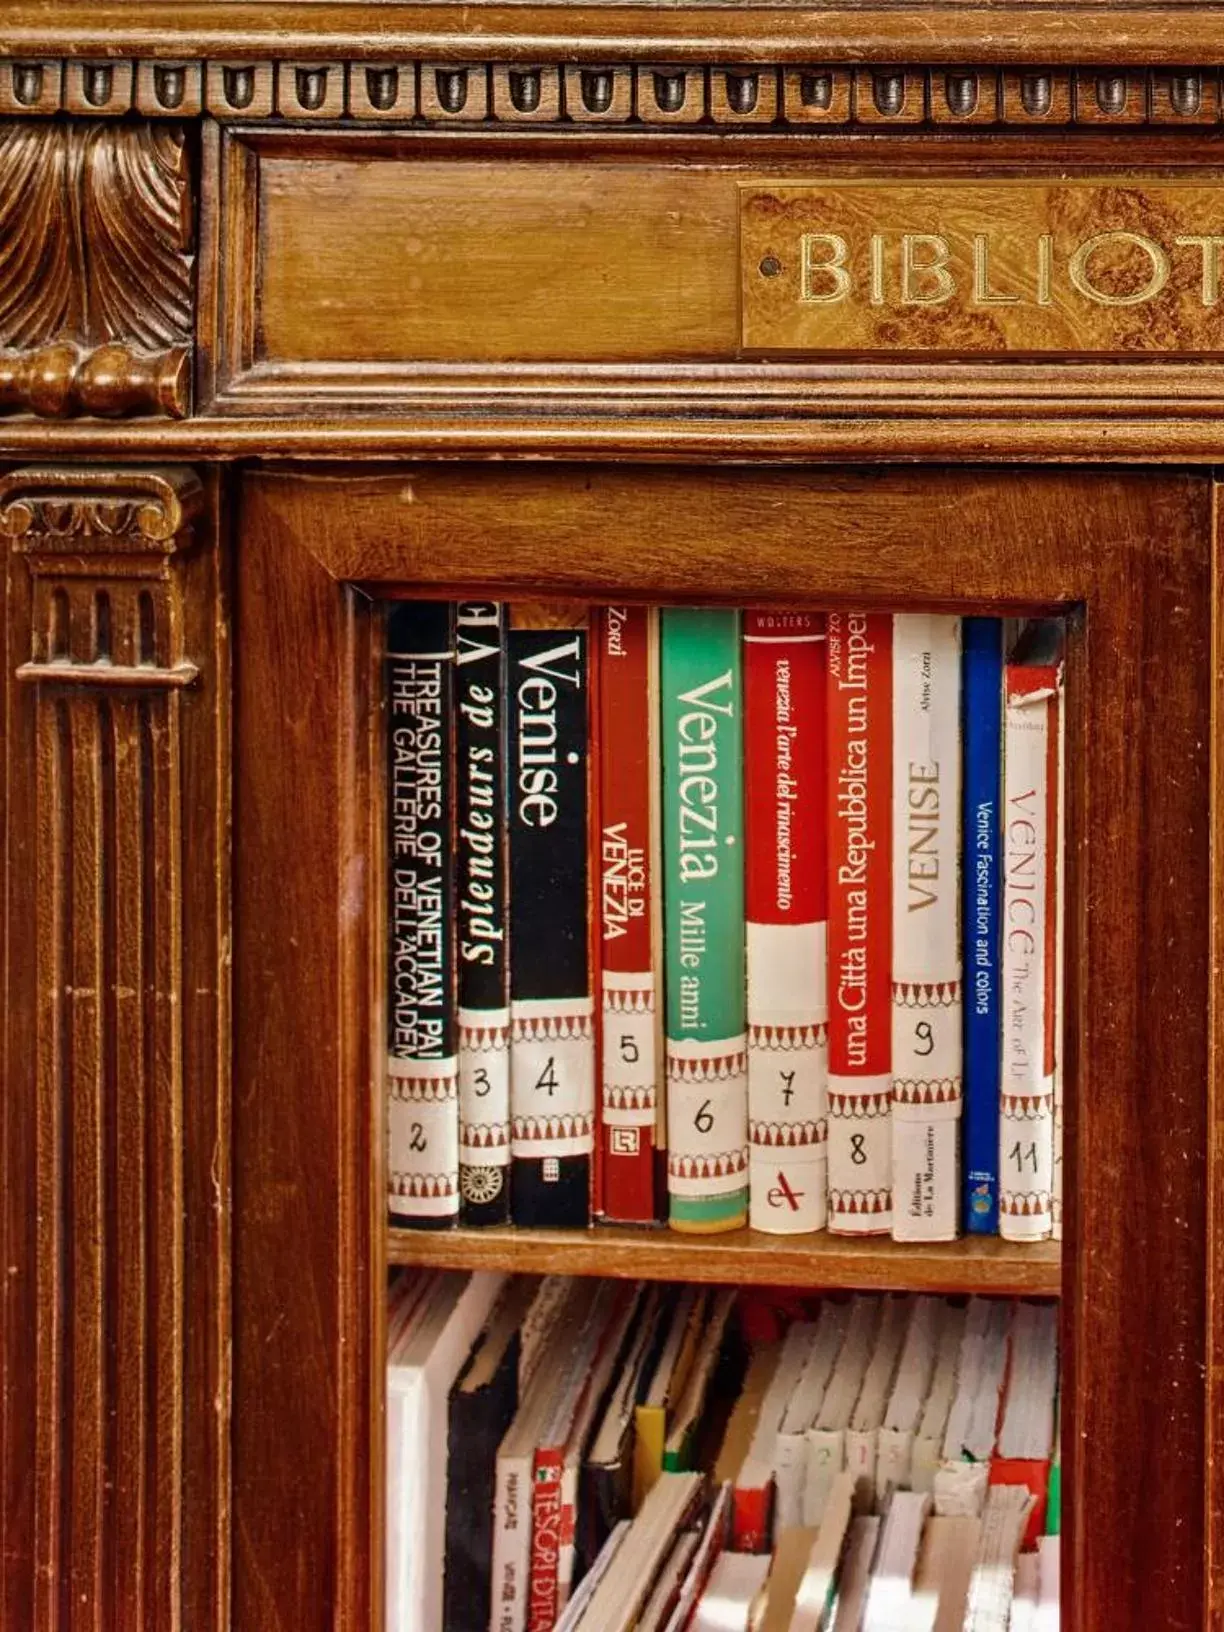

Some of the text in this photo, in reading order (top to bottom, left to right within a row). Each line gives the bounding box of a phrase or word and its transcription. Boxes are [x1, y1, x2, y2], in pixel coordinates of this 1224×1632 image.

[393, 663, 416, 715] THE
[461, 685, 494, 728] de
[775, 659, 790, 722] venezia
[415, 662, 441, 820] TREASURES
[517, 636, 580, 828] Venise
[848, 698, 868, 735] un
[393, 728, 417, 856] GALLERIE
[775, 774, 797, 799] del
[839, 740, 876, 885] Repubblica
[908, 761, 939, 913] VENISE
[977, 801, 993, 850] Venice
[416, 832, 441, 868] OF
[461, 746, 502, 966] Splendeurs
[677, 669, 736, 1029] Venezia Mille anni
[775, 800, 797, 911] rinascimento
[602, 821, 628, 941] VENEZIA
[628, 849, 644, 918] LUCE DI
[416, 877, 443, 1006] VENETIAN
[848, 895, 868, 939] una
[976, 937, 992, 967] and
[838, 952, 868, 1011] Città
[976, 971, 992, 1015] colors
[619, 1035, 640, 1063] 5
[849, 1017, 868, 1066] una
[913, 1021, 935, 1056] 9
[473, 1068, 491, 1097] 3
[535, 1056, 559, 1096] 4
[779, 1070, 796, 1107] 7
[408, 1122, 428, 1152] 2
[694, 1099, 715, 1134] 6
[850, 1133, 868, 1165] 8
[1009, 1141, 1039, 1174] 11
[532, 1490, 561, 1572] TESORI
